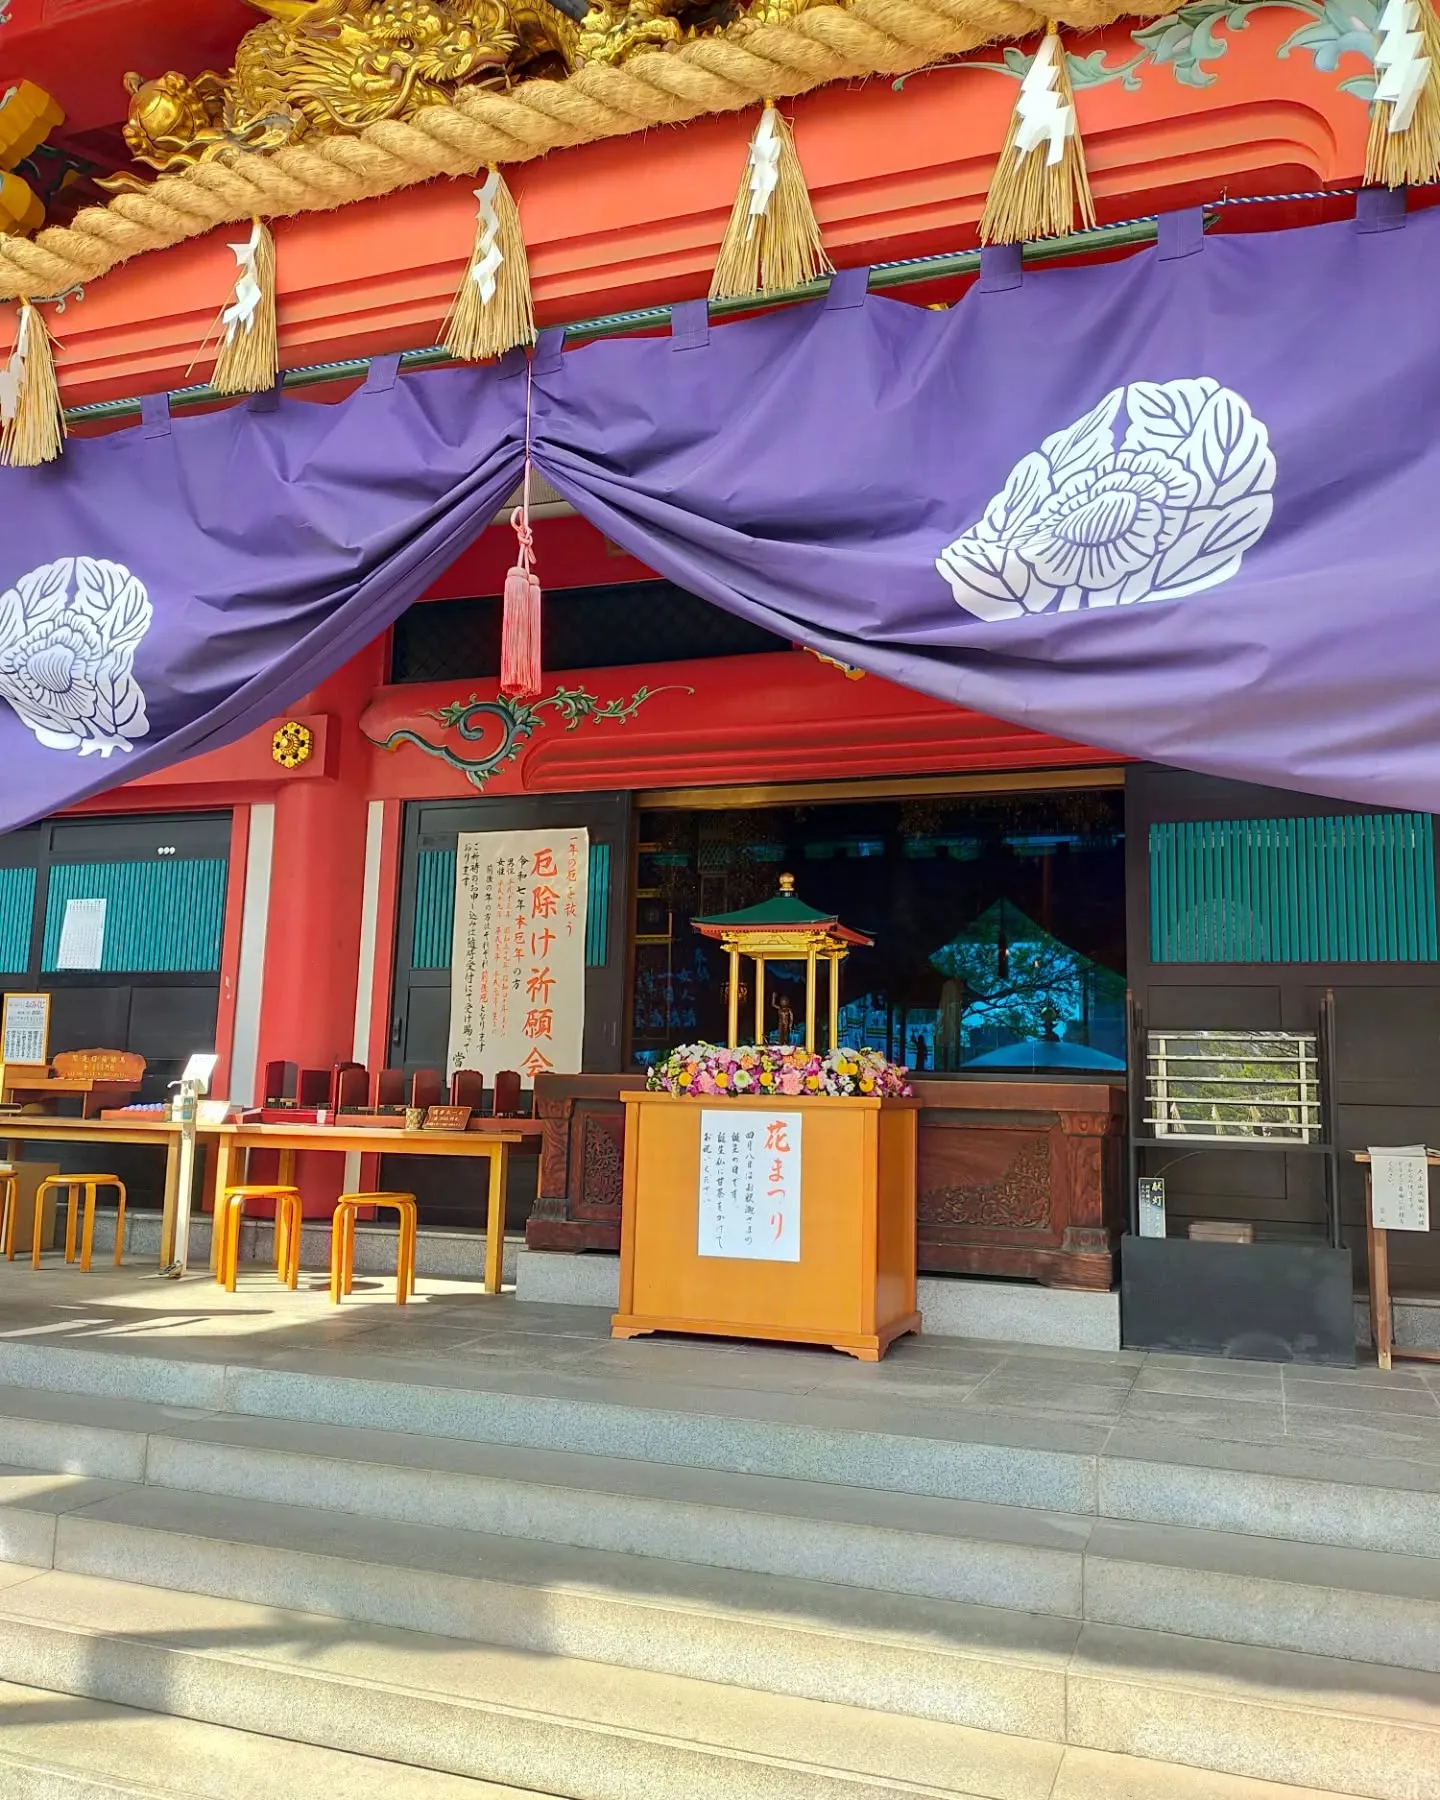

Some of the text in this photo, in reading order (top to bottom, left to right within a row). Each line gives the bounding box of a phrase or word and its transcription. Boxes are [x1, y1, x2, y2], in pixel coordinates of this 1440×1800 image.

[496, 858, 506, 876] 女性
[511, 855, 530, 990] 令和七年本厄年の方
[564, 836, 579, 937] 一年の厄を祓う
[521, 848, 560, 1078] 厄除け祈願会
[764, 1120, 790, 1244] 花まつり
